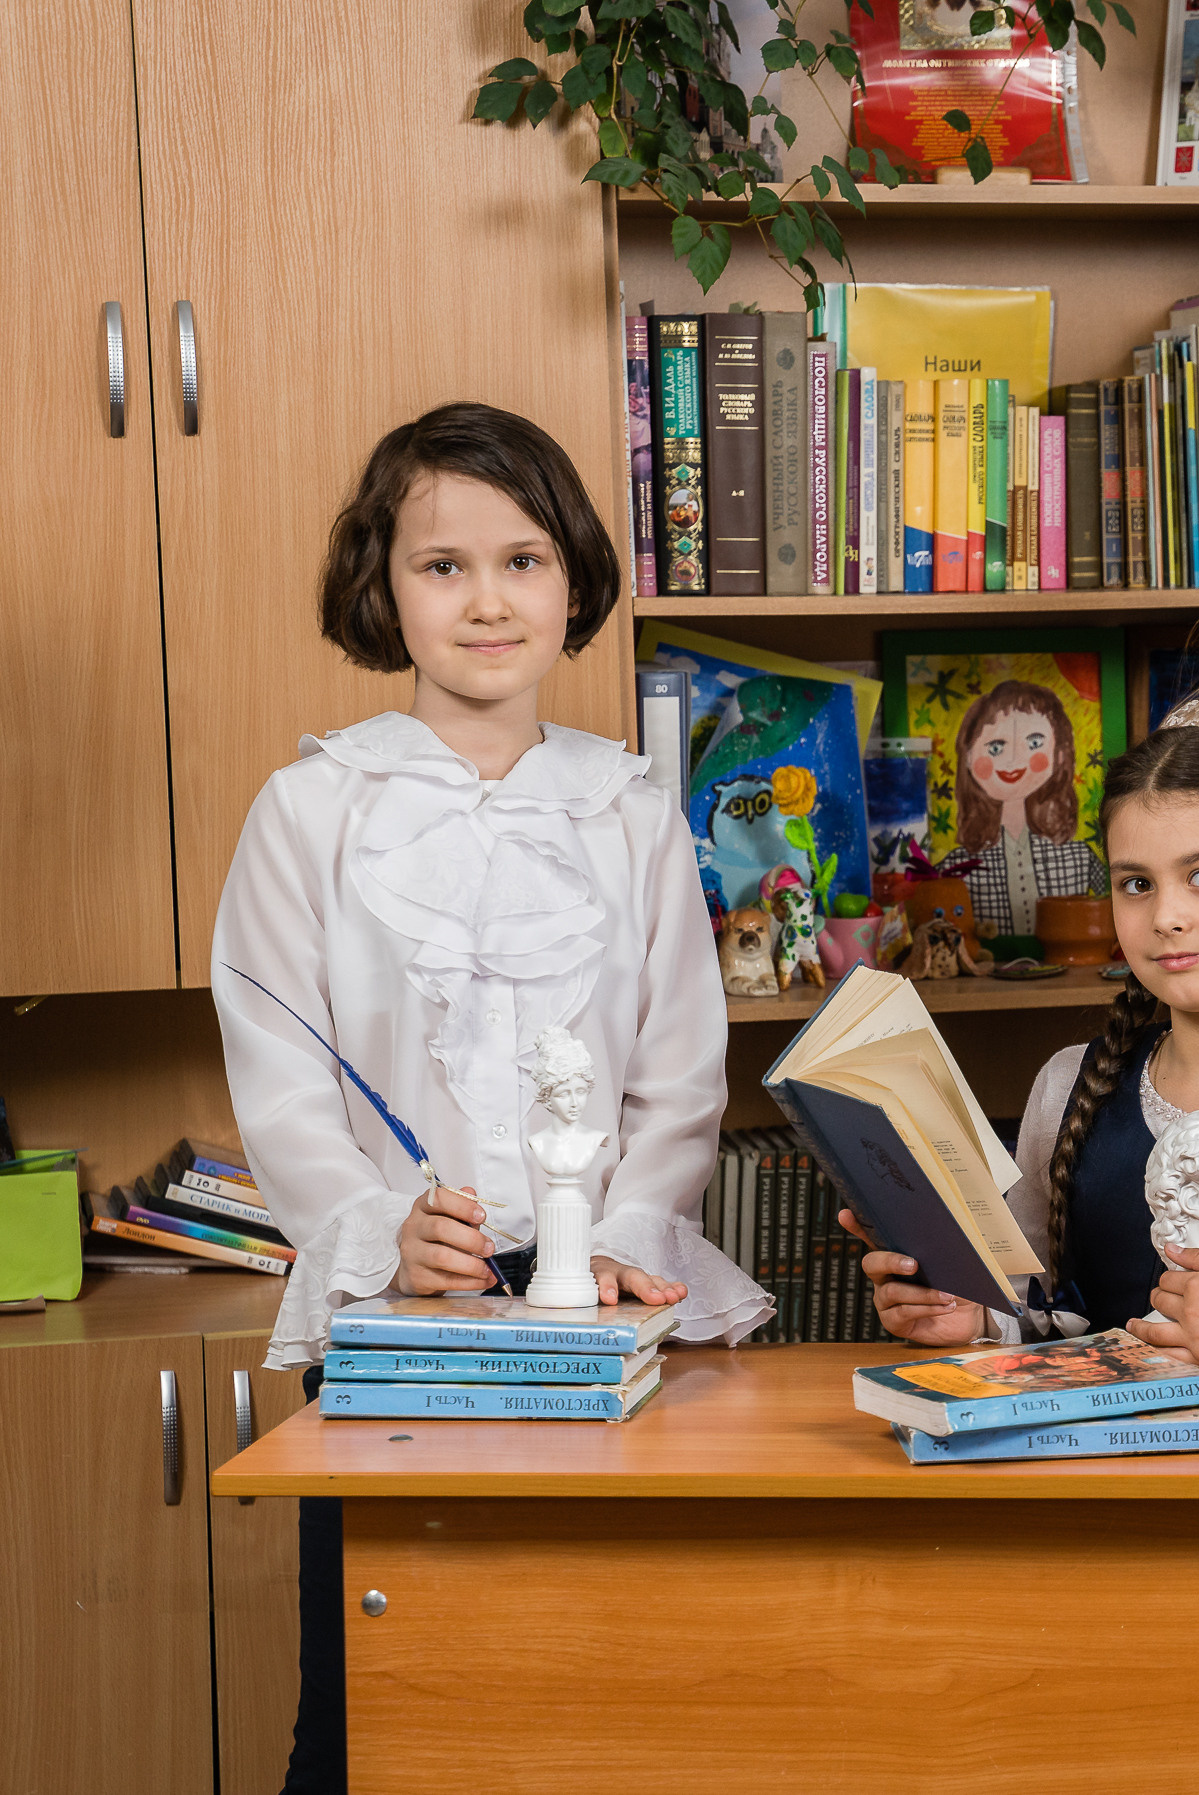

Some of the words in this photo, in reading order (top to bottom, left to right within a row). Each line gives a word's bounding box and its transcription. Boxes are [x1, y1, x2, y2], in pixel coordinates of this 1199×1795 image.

[675, 349, 685, 388] СЛОВАРЬ
[683, 355, 692, 385] ЯЗЫКА
[924, 354, 982, 373] Наши
[676, 389, 686, 436] ТОЛКОВЫЙ
[684, 385, 693, 430] РУССКОГО
[771, 379, 784, 451] СЛОВАРЬ
[785, 385, 798, 440] ЯЗЫКА
[813, 355, 827, 447] ПОСЛОВИЦЫ
[863, 379, 875, 420] СЛОВА
[972, 403, 985, 443] СЛОВАРЬ
[891, 427, 901, 463] СЛОВАРЬ
[1043, 427, 1053, 472] СЛОВАРЬ
[1053, 428, 1062, 456] СЛОВ
[771, 455, 785, 533] УЧЕБНЫЙ
[786, 444, 799, 528] РУССКОГО
[814, 449, 827, 522] РУССКОГО
[1043, 473, 1053, 527] НОВЕЙШИЙ
[1053, 457, 1062, 527] ИНОСТРАННЫХ
[892, 469, 901, 558] ОРФОГРАФИЧЕСКИЙ
[815, 524, 828, 581] НАРОДА
[655, 683, 668, 694] 80
[761, 1156, 772, 1169] 4
[780, 1155, 791, 1168] 4
[798, 1155, 808, 1169] 4
[190, 1193, 233, 1212] СТАРИК
[761, 1176, 771, 1227] РУССКИЙ
[779, 1176, 789, 1226] РУССКИЙ
[796, 1176, 807, 1226] РУССКИЙ
[122, 1227, 156, 1241] Лондон
[760, 1228, 770, 1260] ЯЗЫК
[778, 1227, 788, 1259] ЯЗЫК
[795, 1228, 804, 1260] ЯЗЫК
[349, 1323, 365, 1335] 3
[510, 1328, 620, 1347] ХРЕСТОМАТИЯ.
[338, 1359, 355, 1371] 3
[474, 1359, 602, 1376] ХРЕСТОМАТИЯ.
[335, 1393, 351, 1405] 3
[499, 1396, 610, 1413] ХРЕСТОМАТИЯ.
[960, 1410, 976, 1426] 3
[932, 1439, 950, 1452] 3
